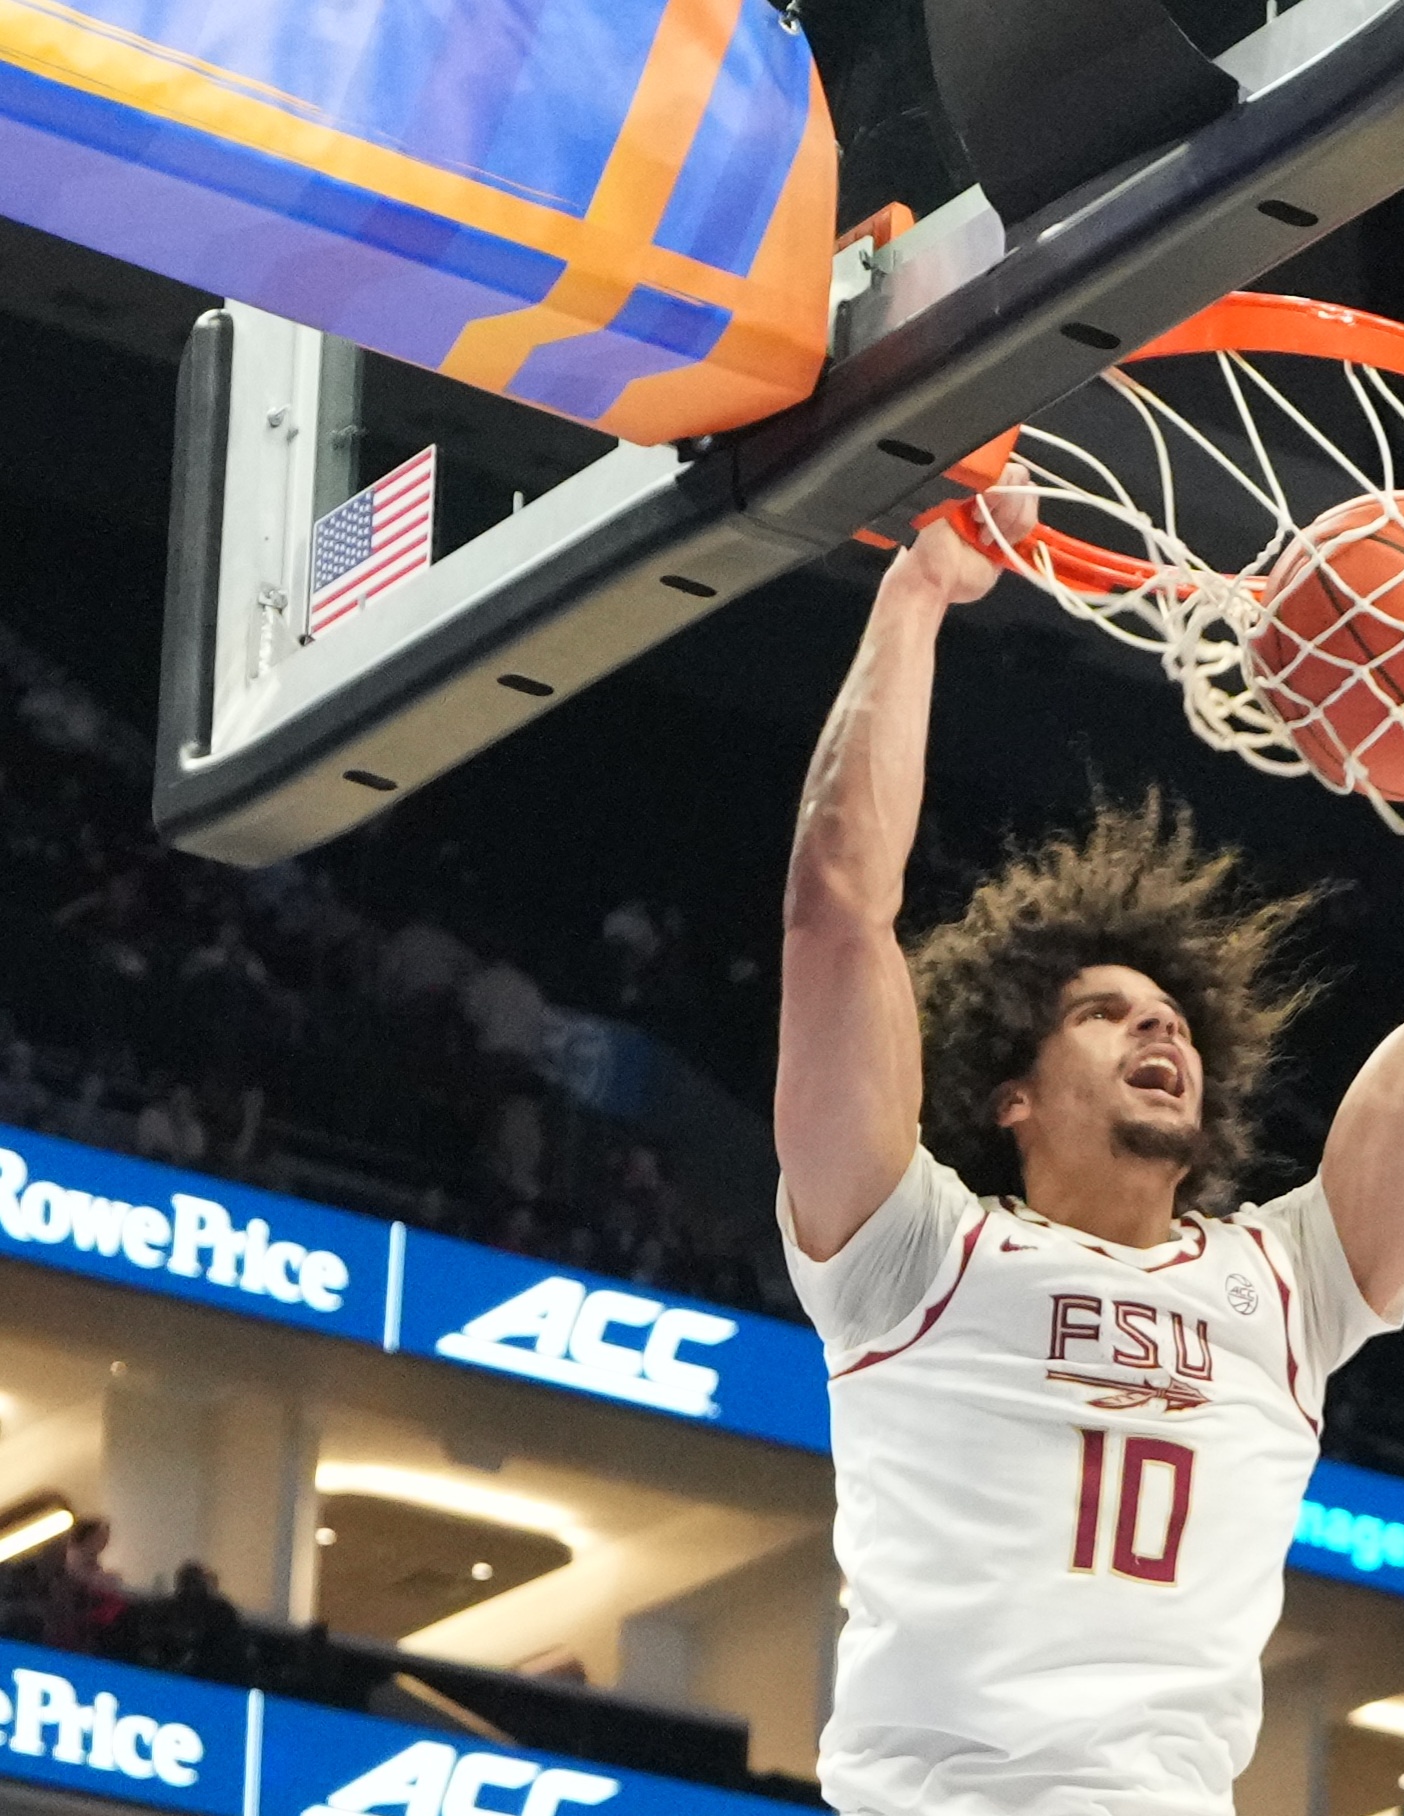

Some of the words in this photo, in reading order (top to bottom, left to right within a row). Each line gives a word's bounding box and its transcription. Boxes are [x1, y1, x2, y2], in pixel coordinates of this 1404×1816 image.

[462, 1276, 740, 1396] ACC
[1047, 1293, 1213, 1382] FSU
[1068, 1425, 1198, 1588] 10
[0, 1667, 205, 1788] Price
